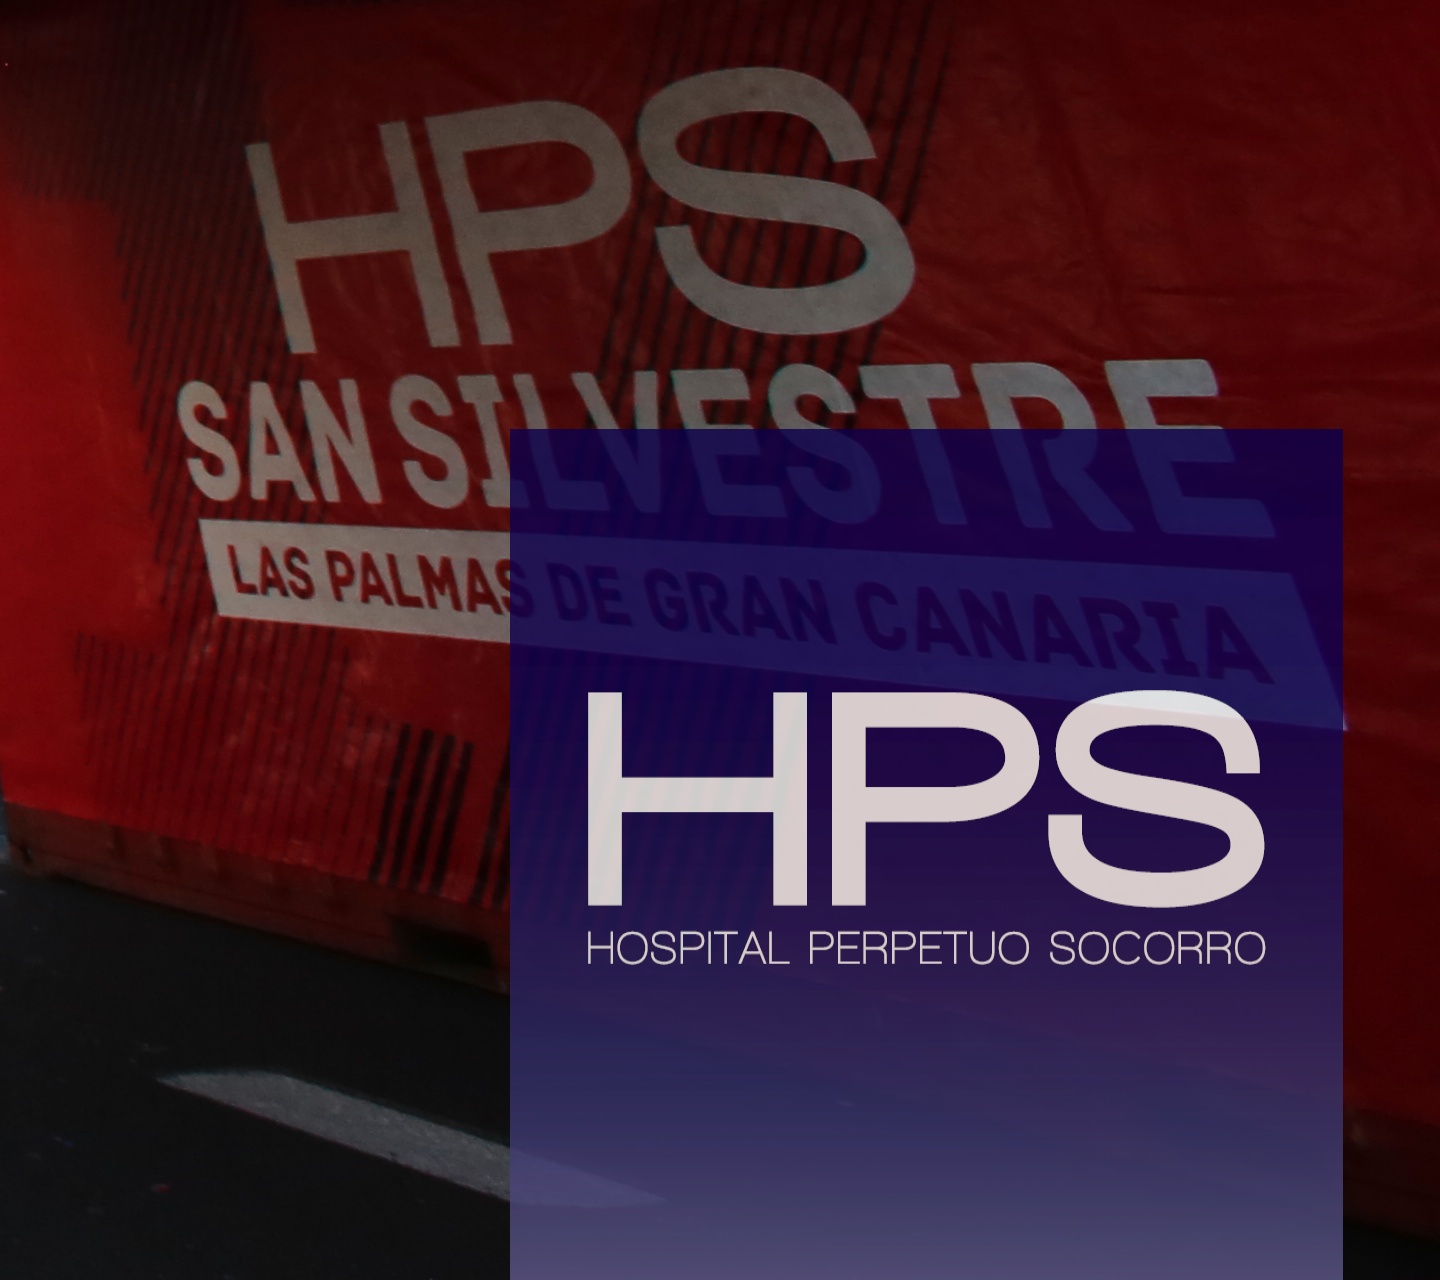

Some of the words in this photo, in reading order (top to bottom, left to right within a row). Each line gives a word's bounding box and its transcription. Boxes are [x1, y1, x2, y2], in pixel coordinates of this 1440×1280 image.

[245, 66, 916, 355] HPS
[177, 379, 383, 507] SAN
[388, 358, 1278, 540] SILVESTRE
[224, 544, 316, 602] LAS
[325, 549, 545, 618] PALMAS
